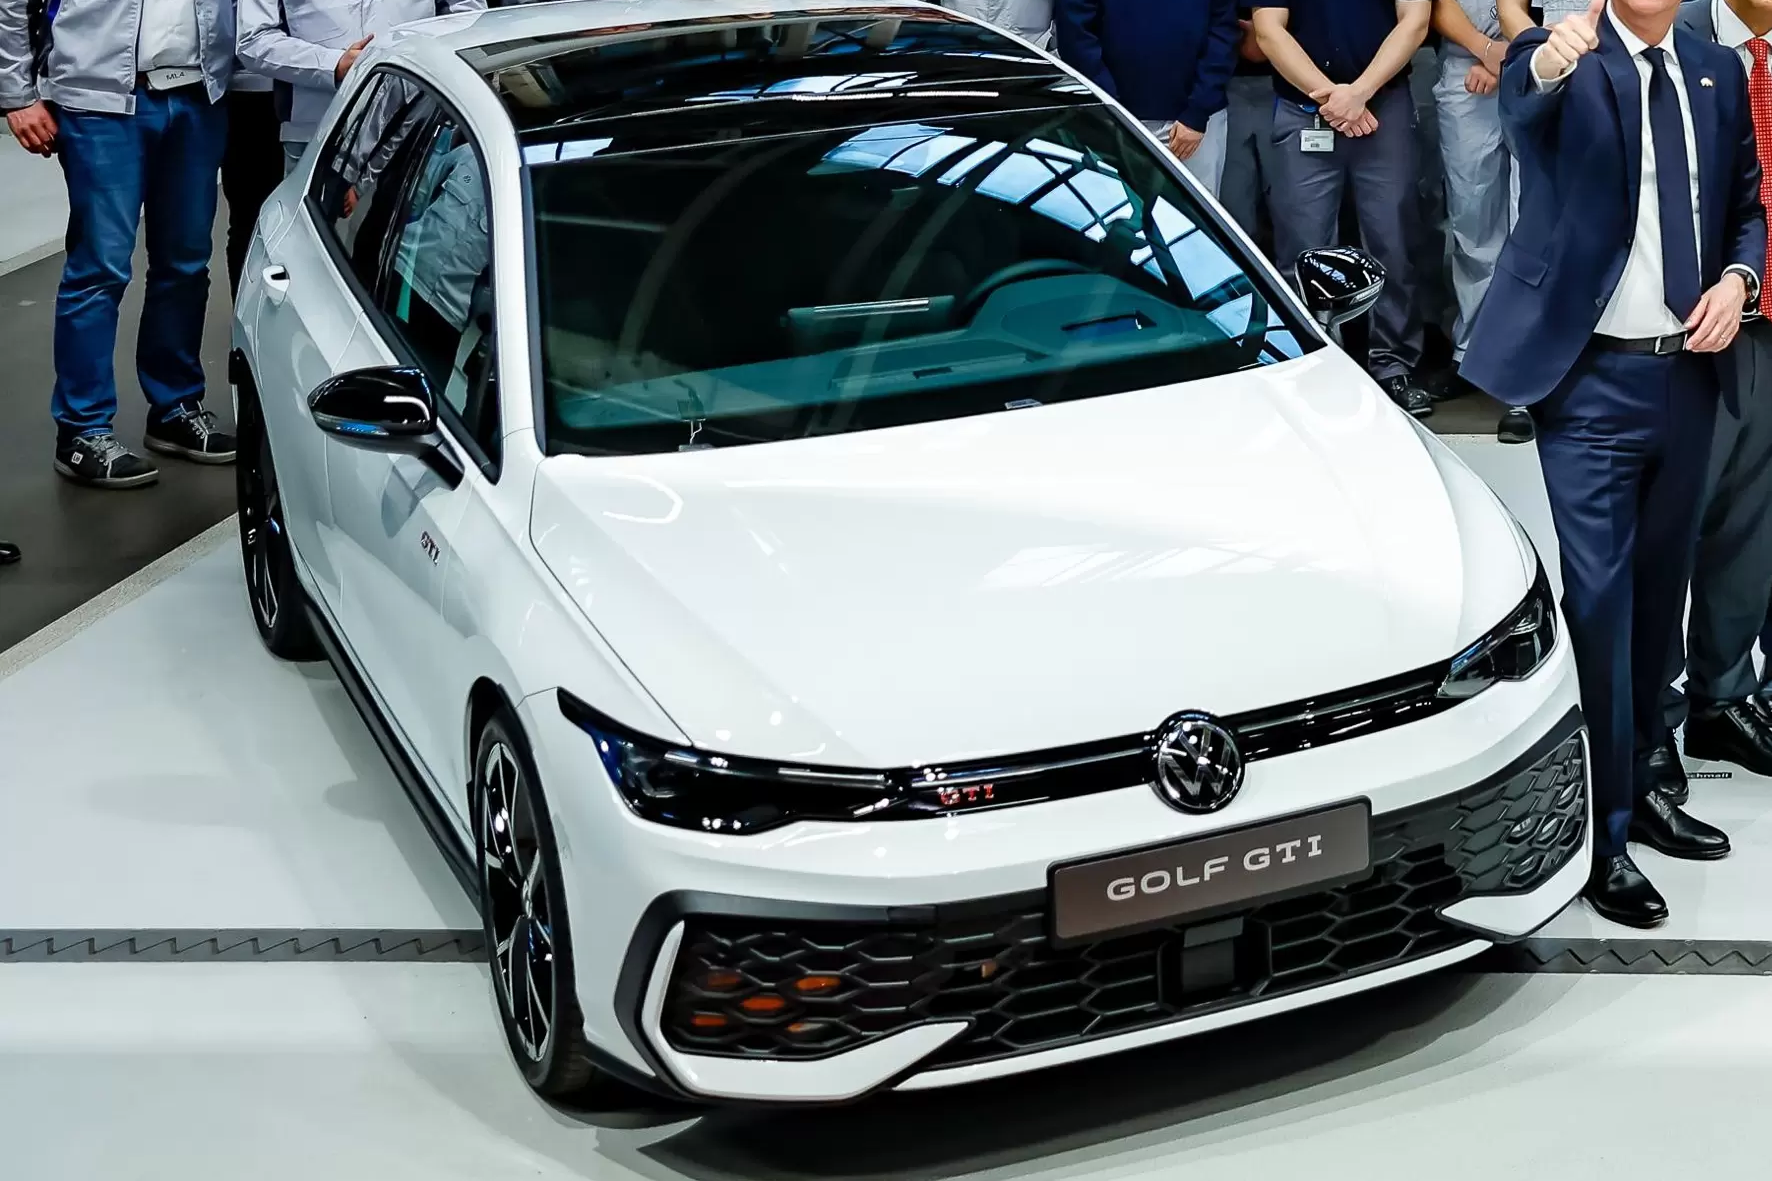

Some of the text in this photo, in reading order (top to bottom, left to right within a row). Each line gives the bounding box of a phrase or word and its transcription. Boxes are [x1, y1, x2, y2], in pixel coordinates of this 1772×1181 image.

[421, 531, 440, 566] GTI
[1157, 720, 1242, 809] VW
[939, 784, 995, 805] GTI
[1106, 834, 1322, 902] GOLF GTI
